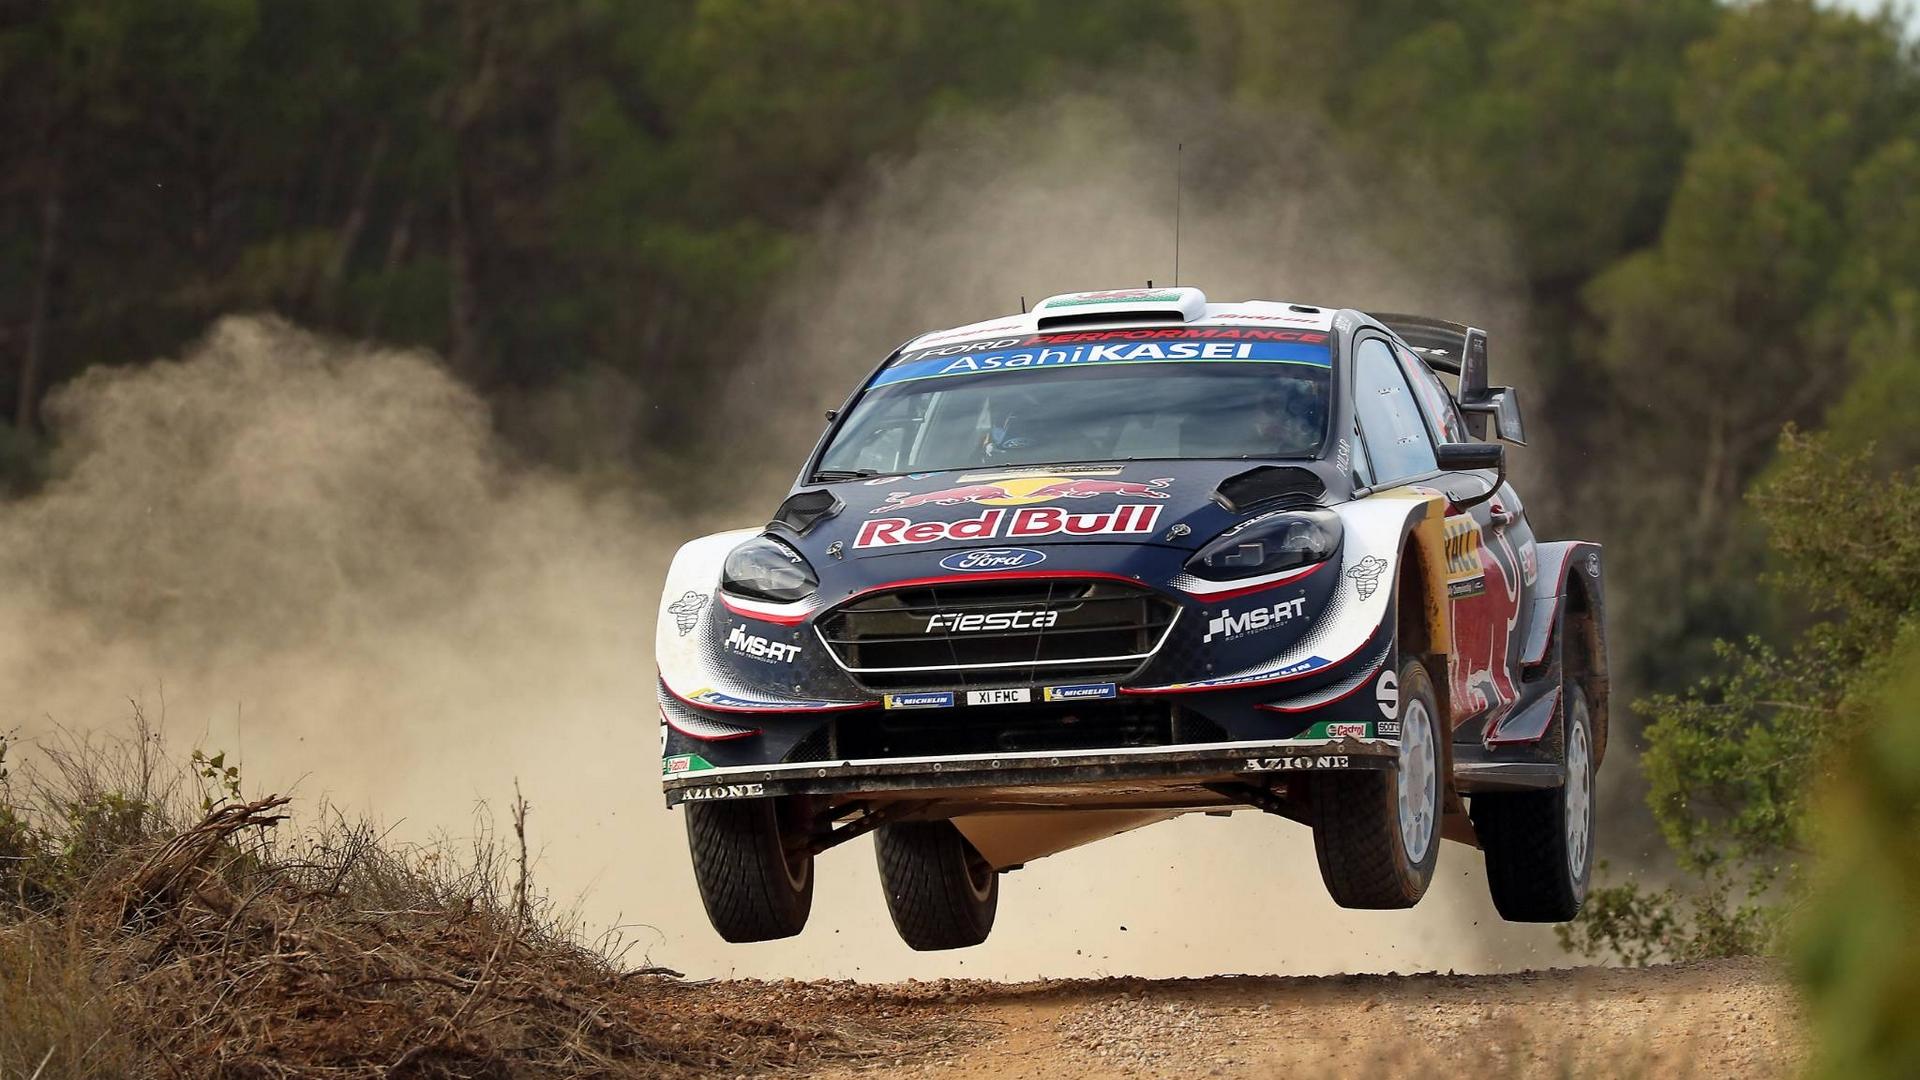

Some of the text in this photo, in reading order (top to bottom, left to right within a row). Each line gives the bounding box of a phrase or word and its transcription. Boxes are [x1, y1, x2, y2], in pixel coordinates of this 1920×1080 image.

[915, 339, 1020, 361] FORD
[1022, 327, 1328, 346] PERFORMANCE
[856, 505, 1161, 547] Red Bull
[959, 551, 1026, 569] Ford
[925, 609, 1058, 632] Fiesta
[995, 690, 1019, 702] FMC
[1064, 687, 1110, 697] MICHELIN
[903, 696, 948, 706] MICHELIN
[1337, 724, 1364, 736] Castrol
[1379, 722, 1400, 731] sparc
[1243, 755, 1349, 770] AZIONE
[682, 783, 764, 801] AZIONE
